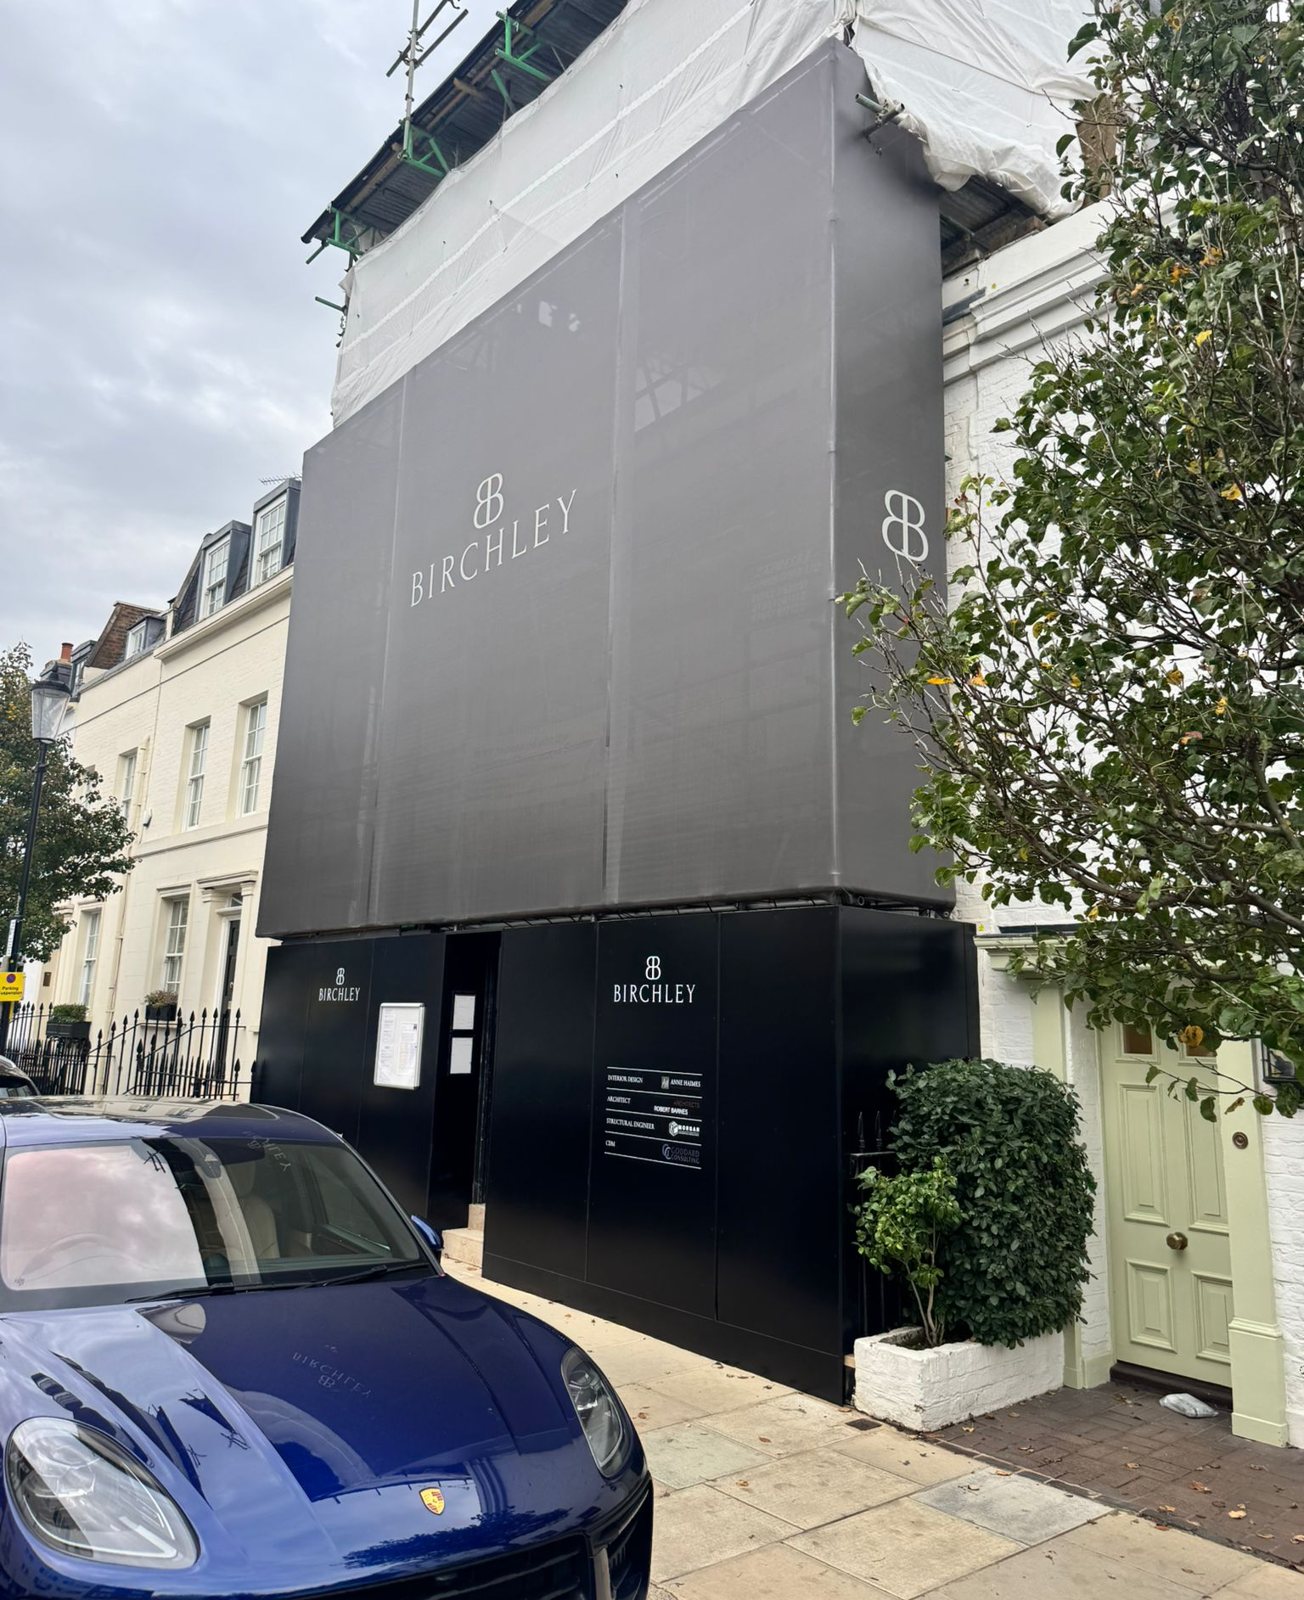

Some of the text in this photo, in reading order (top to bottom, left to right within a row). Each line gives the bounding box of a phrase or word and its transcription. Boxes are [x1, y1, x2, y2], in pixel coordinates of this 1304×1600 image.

[410, 488, 577, 608] BIRCHLEY
[318, 987, 361, 1002] BIRCHLEY
[613, 984, 696, 1003] BIRCHLEY
[607, 1074, 627, 1082] INTERIOR
[607, 1095, 631, 1104] ARCHITECT
[653, 1105, 689, 1115] ROBERT BARNES
[606, 1118, 655, 1130] STRUCTURAL ENGINEER
